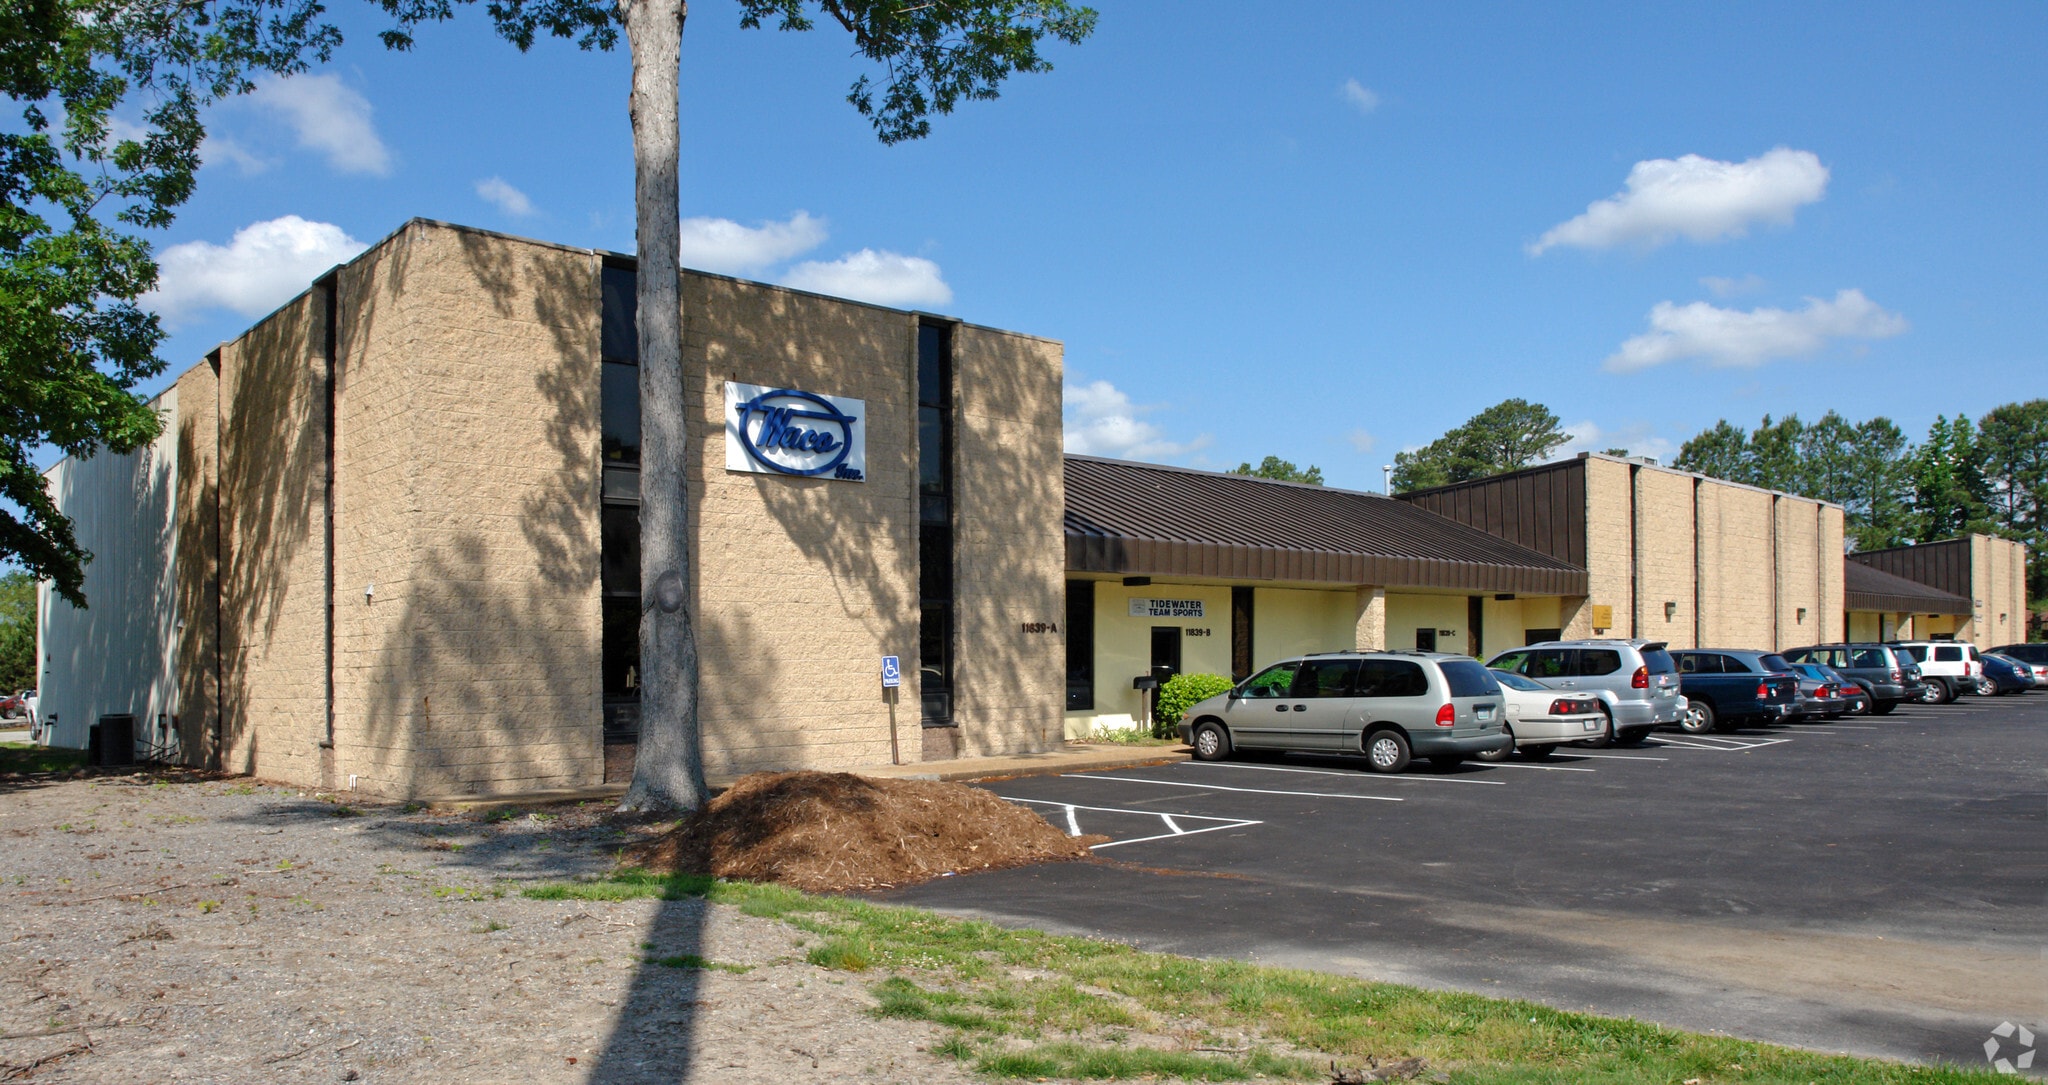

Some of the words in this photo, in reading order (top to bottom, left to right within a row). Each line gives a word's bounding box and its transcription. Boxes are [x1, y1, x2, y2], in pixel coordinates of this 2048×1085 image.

[1150, 599, 1202, 609] TIDEWATER
[1148, 608, 1171, 616] TEAM
[1172, 609, 1203, 617] SPORTS
[1021, 622, 1058, 634] 11839-A
[1185, 628, 1211, 637] 11839-B
